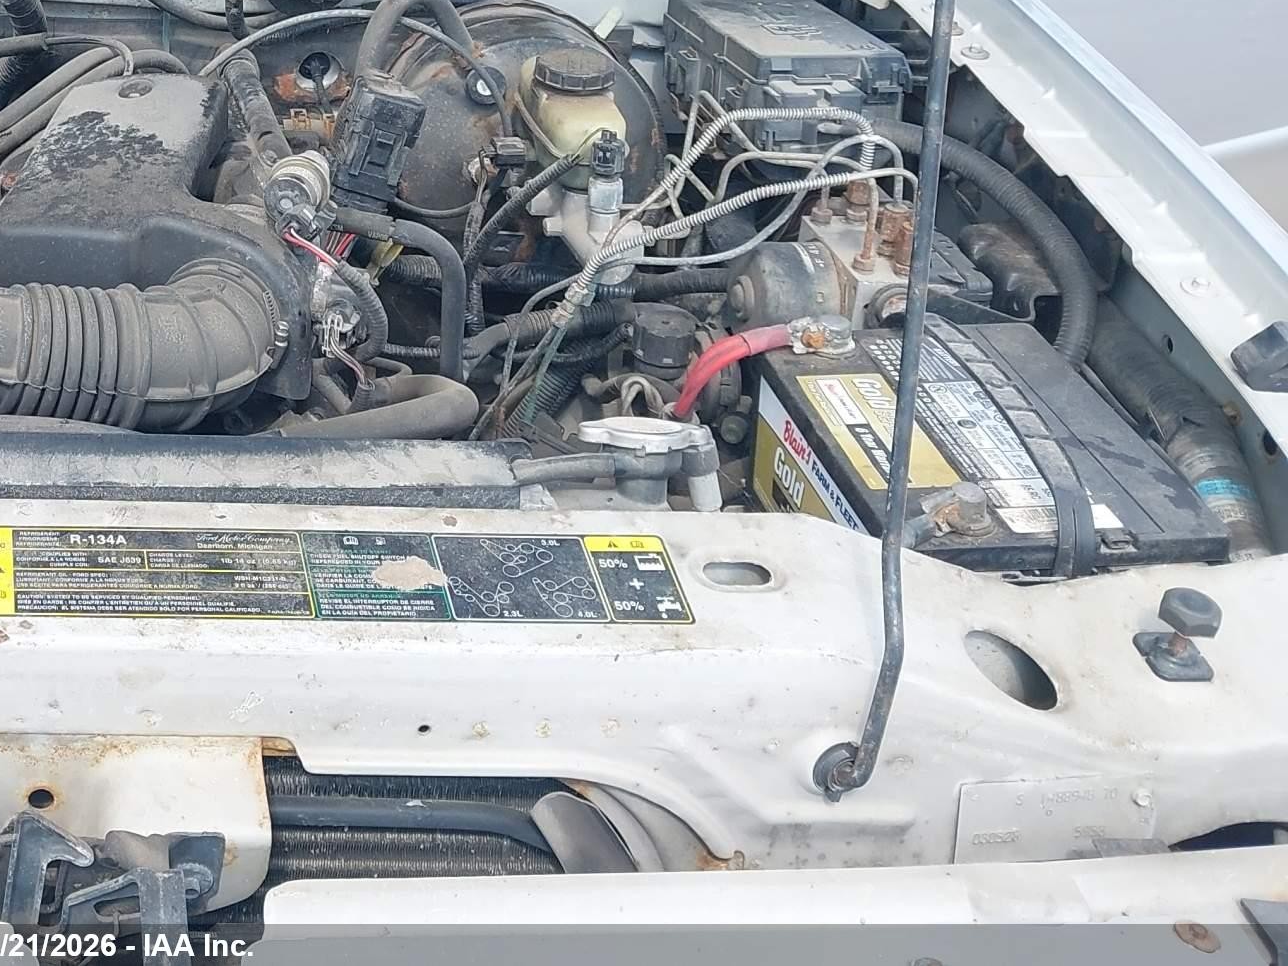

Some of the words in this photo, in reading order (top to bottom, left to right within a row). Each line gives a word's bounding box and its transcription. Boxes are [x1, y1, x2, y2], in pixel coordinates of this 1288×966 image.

[851, 378, 897, 410] Gold
[774, 446, 805, 509] Gold
[783, 419, 812, 464] Blain's
[811, 459, 830, 494] FARM
[829, 489, 835, 500] &
[835, 495, 860, 531] FLEET
[69, 533, 127, 545] R-134A
[237, 542, 273, 551] Michigan
[97, 556, 118, 564] SAE
[598, 558, 628, 569] 50%
[614, 601, 645, 612] 50%
[503, 610, 523, 618] 2.3L
